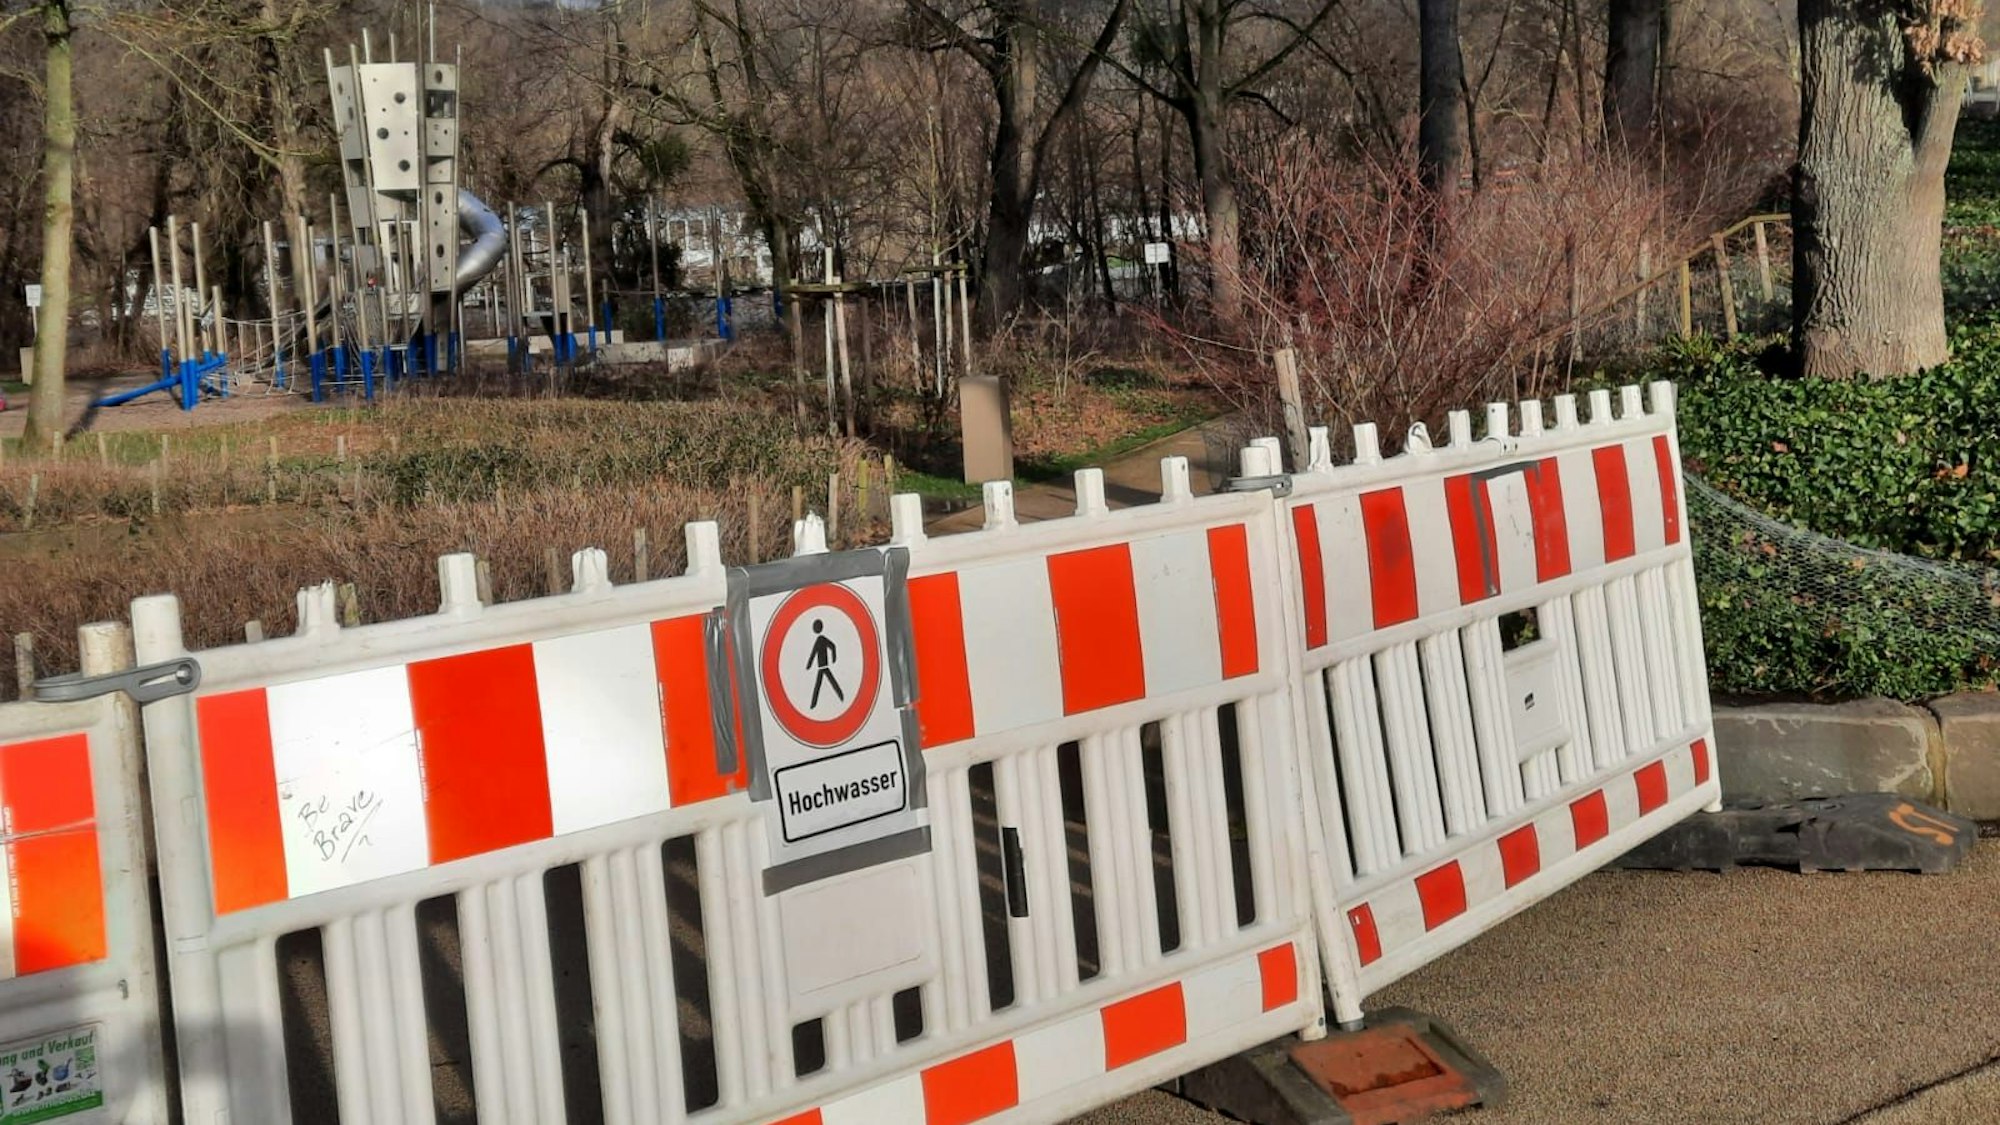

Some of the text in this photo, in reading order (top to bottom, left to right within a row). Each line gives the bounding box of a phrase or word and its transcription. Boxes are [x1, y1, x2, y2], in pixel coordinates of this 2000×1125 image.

[297, 794, 330, 833] Be
[788, 771, 897, 815] Hochwasser
[313, 790, 374, 862] Brave
[0, 1031, 94, 1067] ng und Verkauf
